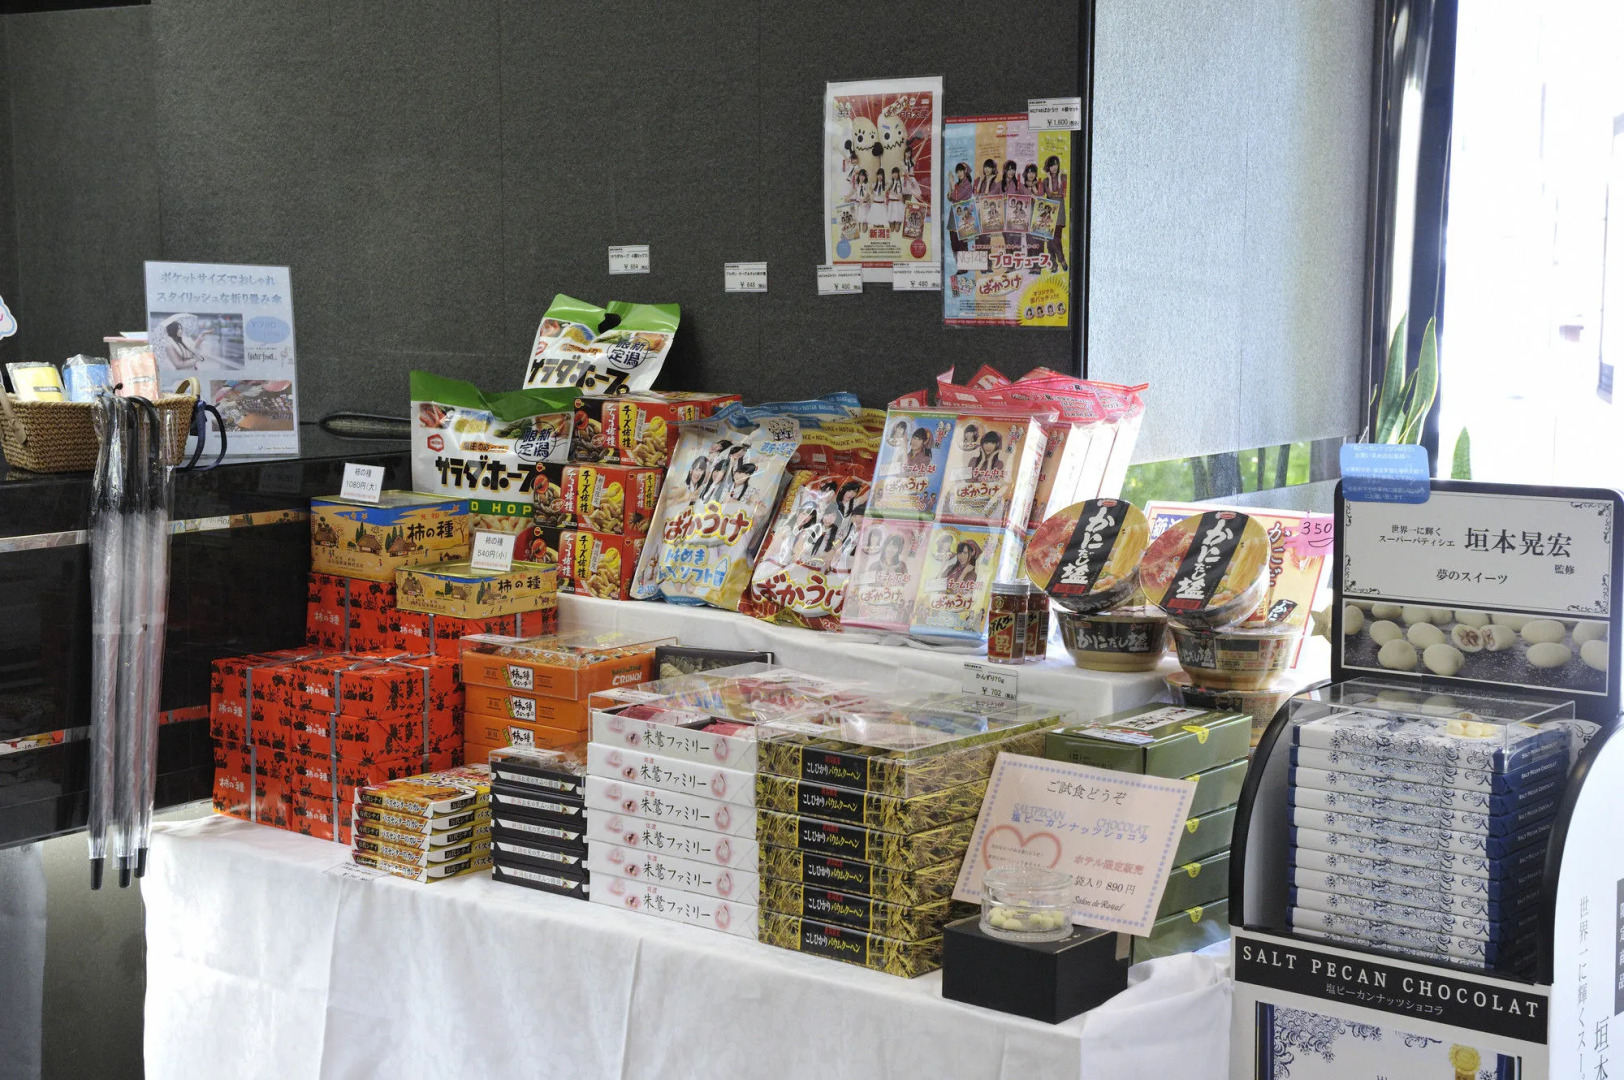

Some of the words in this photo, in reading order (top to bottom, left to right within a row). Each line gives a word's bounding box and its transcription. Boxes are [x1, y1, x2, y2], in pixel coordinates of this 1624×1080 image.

[161, 272, 276, 285] ポケットサイズでおしゃれ
[979, 275, 1022, 295] ばかうけ
[528, 354, 630, 395] サラダホープ
[957, 482, 1000, 497] ばかうけ
[407, 520, 454, 543] 柿の種
[664, 503, 750, 543] ばかうけ
[1301, 521, 1332, 535] 350
[1391, 524, 1441, 536] 世界一に輝く
[1060, 506, 1115, 584] かにだし塩
[1379, 535, 1455, 547] スーパーパティシエ
[1464, 527, 1572, 558] 垣本晃宏
[1175, 519, 1234, 599] かにだし塩
[1554, 564, 1575, 575] 監修
[497, 576, 541, 594] 柿の種
[1436, 568, 1508, 585] 夢のスイーツ
[753, 573, 846, 614] ばかうけ
[931, 594, 973, 610] ばかうけ
[314, 611, 340, 625] 柿の種
[400, 626, 422, 637] 柿の種
[1076, 628, 1149, 651] かにだし塩
[306, 684, 329, 697] 柿の種
[218, 702, 243, 717] 柿の種
[305, 725, 326, 737] 柿の種
[643, 730, 709, 752] 朱鷺ファミリー
[218, 777, 245, 793] 柿の種
[305, 769, 328, 781] 柿の種
[640, 764, 706, 788] 朱鷺ファミリー
[1046, 780, 1127, 805] ご試食どうぞ
[305, 811, 328, 822] 柿の種
[641, 798, 710, 821] 朱鷺ファミリー
[1011, 811, 1148, 843] 塩ピーカンナッツショコラ
[642, 831, 711, 854] 朱鷺ファミリー
[643, 862, 711, 886] 朱鷺ファミリー
[1074, 854, 1145, 875] ホテル限定販売
[643, 894, 710, 918] 朱鷺ファミリー
[1072, 895, 1091, 907] Salon
[1091, 898, 1100, 907] de
[1100, 900, 1125, 912] Royal
[1243, 945, 1298, 970] SALT
[1311, 958, 1387, 988] PECAN
[1403, 977, 1540, 1018] CHOCOLAT
[1577, 895, 1590, 1080] 世界一に輝くスー
[1325, 982, 1444, 1016] 塩ピーカンナッツショコラ
